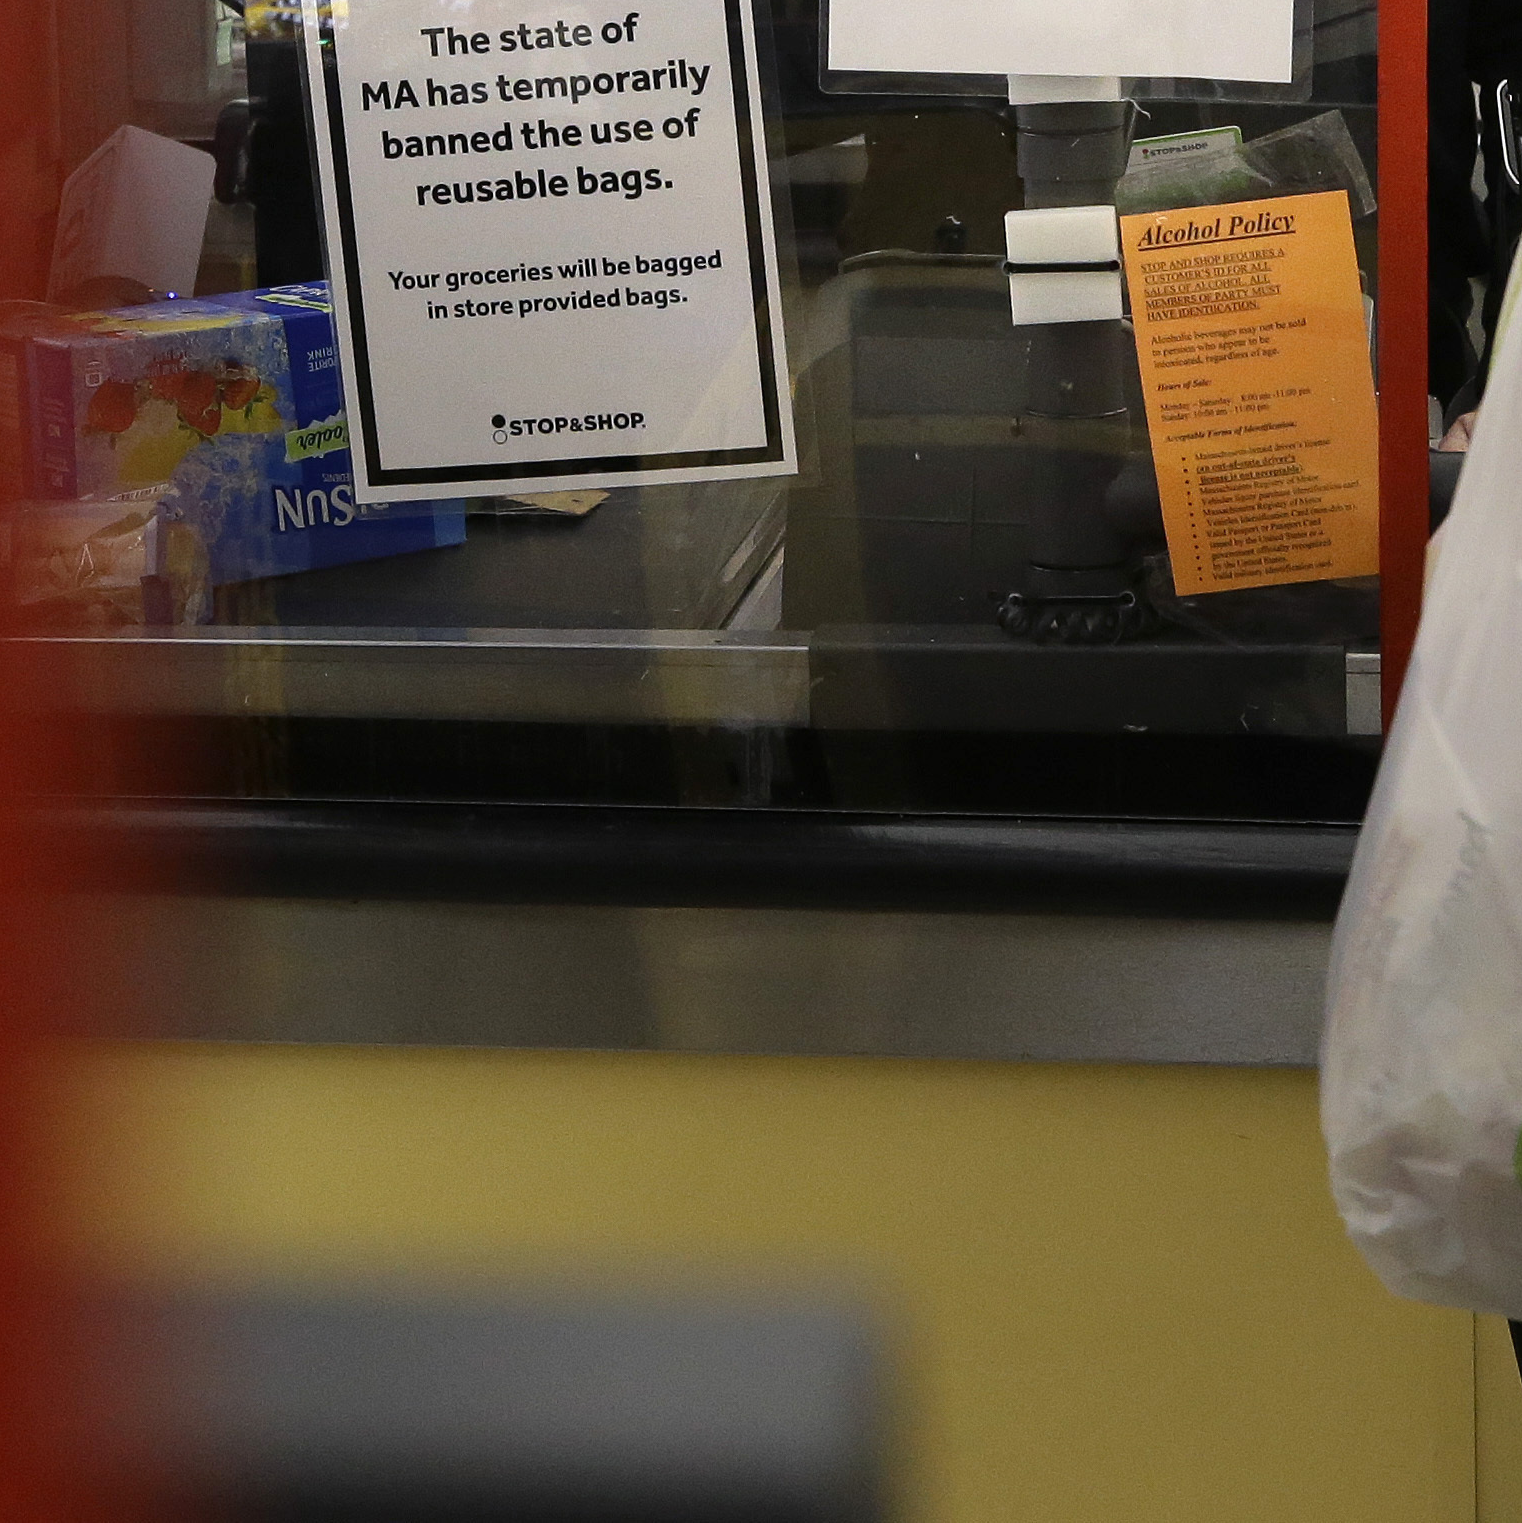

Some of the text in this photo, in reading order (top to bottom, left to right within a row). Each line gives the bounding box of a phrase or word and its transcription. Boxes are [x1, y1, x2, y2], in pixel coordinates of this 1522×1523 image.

[420, 12, 640, 57] The state of
[361, 58, 711, 111] MA has temporarily
[381, 107, 701, 160] banned the use of
[416, 165, 674, 206] reusable bags.
[1137, 211, 1295, 247] Alcohol Policy
[388, 249, 722, 293] Your groceries will be bagged
[427, 286, 689, 320] in store provided bags.
[297, 424, 350, 451] ooler
